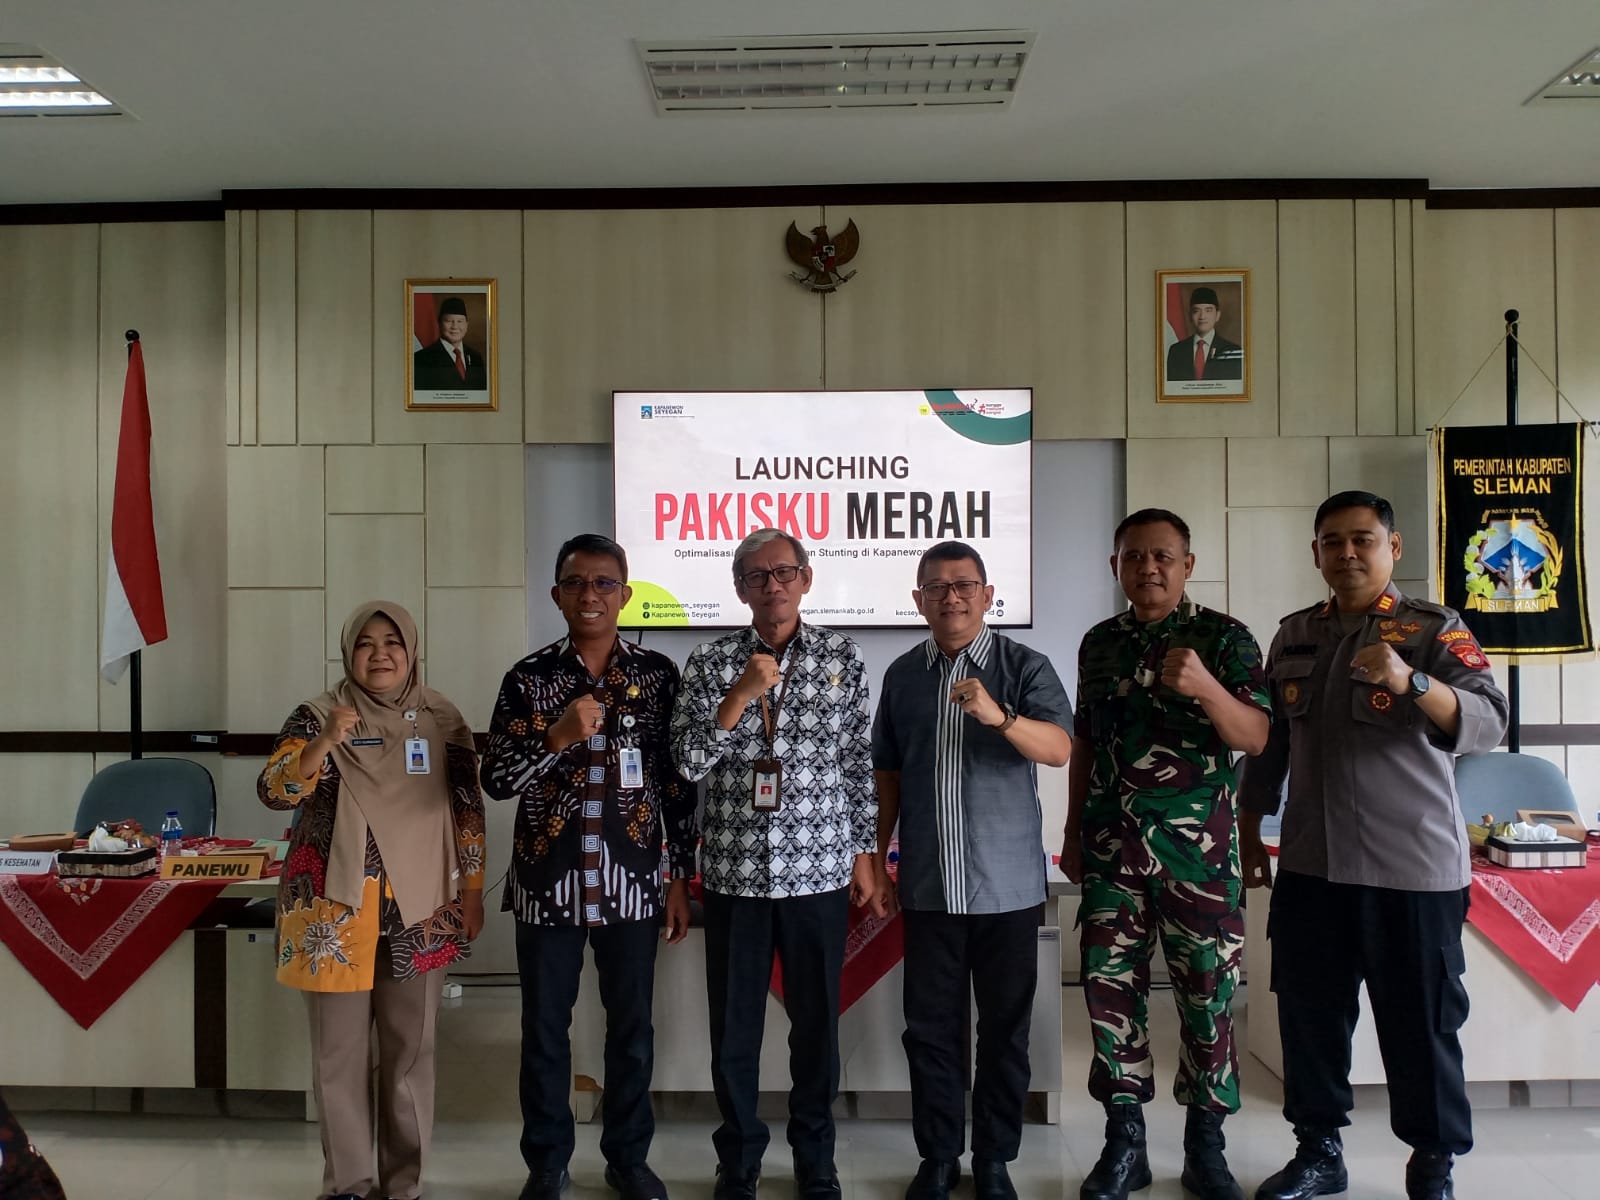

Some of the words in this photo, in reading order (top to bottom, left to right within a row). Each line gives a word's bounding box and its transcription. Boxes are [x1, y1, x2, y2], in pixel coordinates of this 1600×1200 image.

[735, 456, 909, 480] LAUNCHING
[1453, 458, 1513, 476] PEMERINTAH
[1515, 457, 1572, 474] KABUPATEN
[1473, 477, 1551, 495] SLEMAN
[655, 492, 830, 541] PAKISKU
[846, 491, 991, 539] MERAH
[674, 549, 734, 560] Optimalisasi
[818, 548, 858, 558] Stunting
[862, 548, 870, 557] di
[1487, 600, 1539, 611] SLEMAN
[4, 858, 41, 867] KESEHATAN
[171, 863, 250, 877] PANEWU
